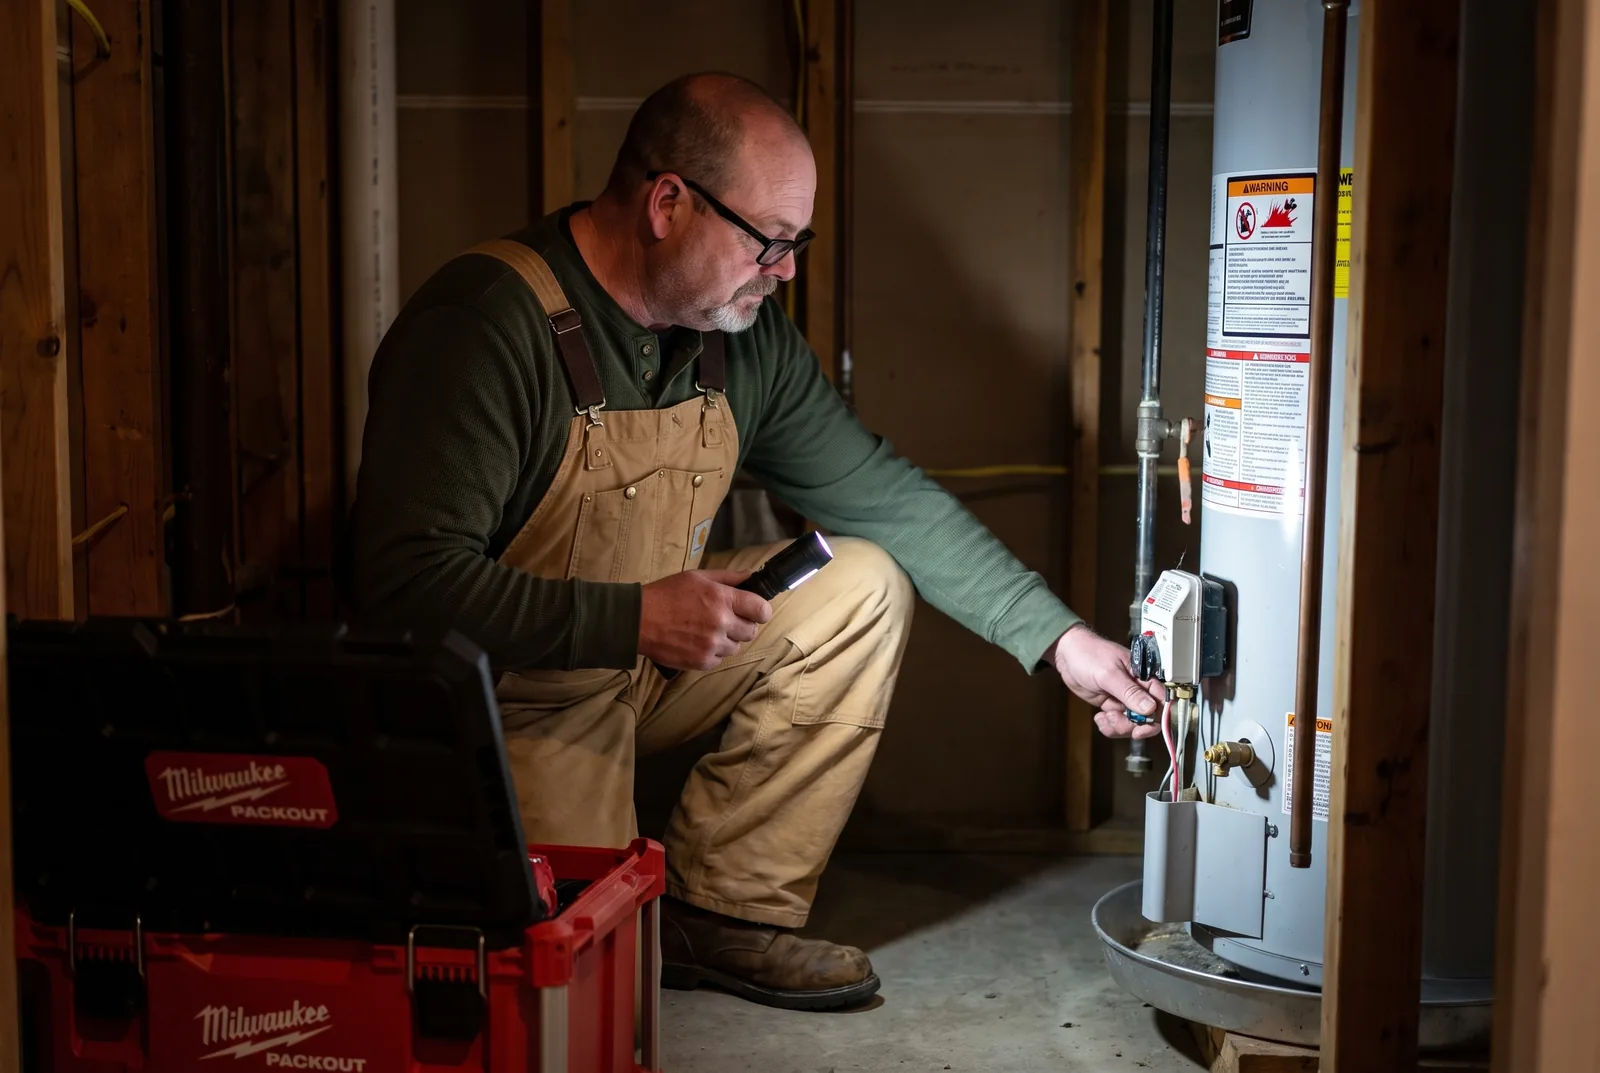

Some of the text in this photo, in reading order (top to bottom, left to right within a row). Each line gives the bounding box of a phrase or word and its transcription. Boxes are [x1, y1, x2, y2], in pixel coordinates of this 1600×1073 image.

[1249, 181, 1289, 193] WARNING
[157, 761, 288, 802] Milwaukee
[231, 805, 328, 822] PACKOUT
[193, 1000, 331, 1046] Milwaukee
[266, 1052, 366, 1072] PACKOUT
